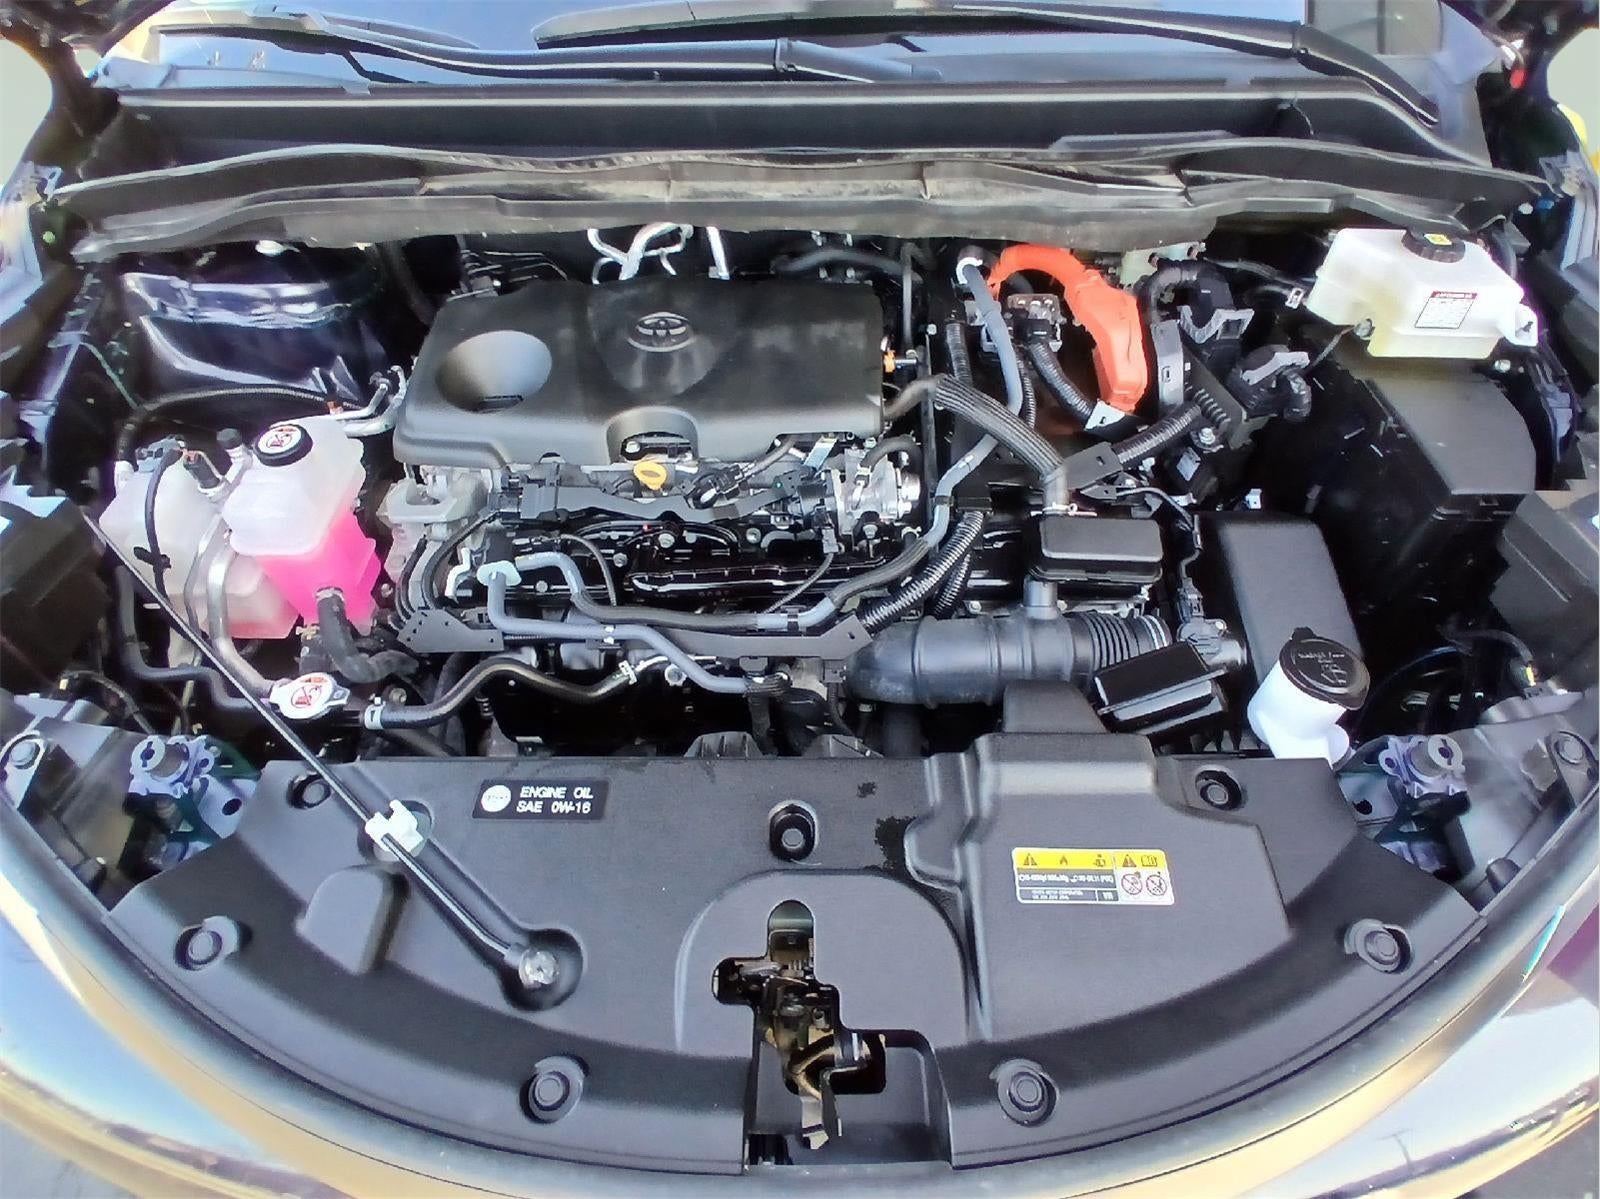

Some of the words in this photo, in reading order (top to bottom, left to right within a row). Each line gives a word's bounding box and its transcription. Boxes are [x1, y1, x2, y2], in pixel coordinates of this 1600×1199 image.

[520, 786, 567, 799] ENGINE
[573, 787, 594, 799] OIL
[516, 801, 543, 813] SAE
[551, 801, 591, 814] 0W-16
